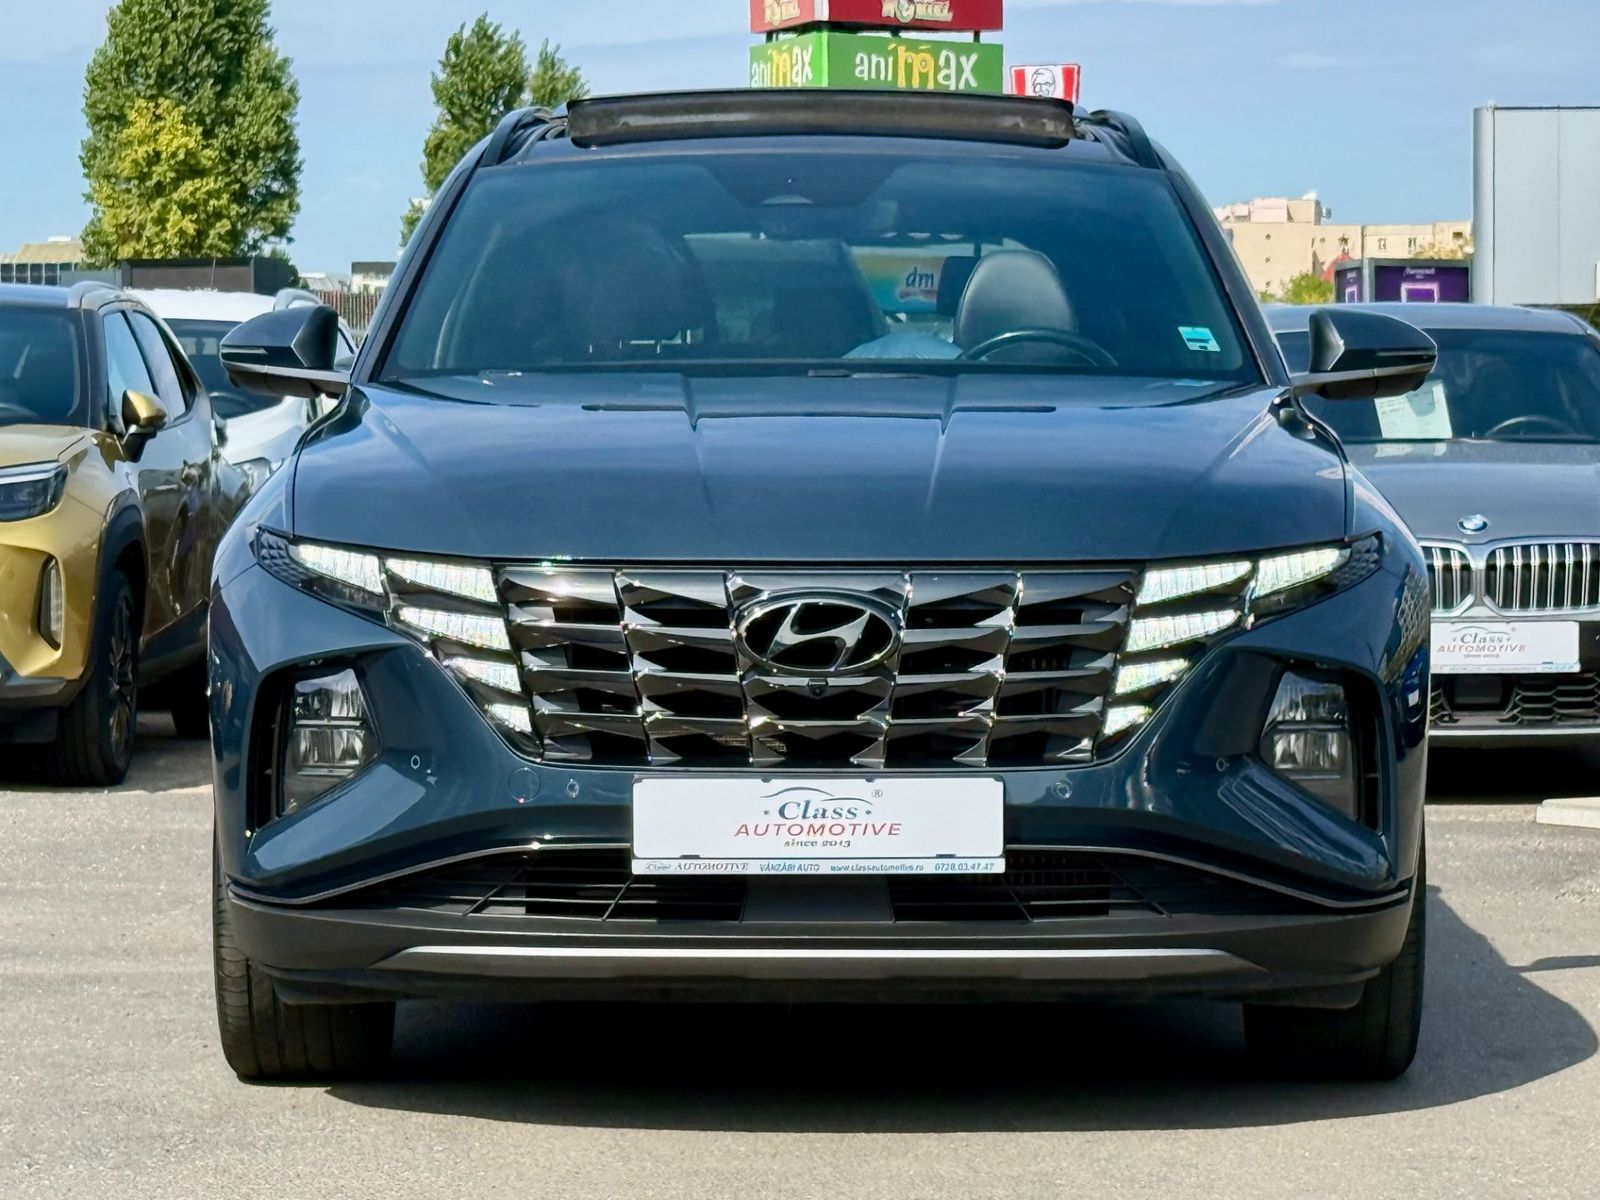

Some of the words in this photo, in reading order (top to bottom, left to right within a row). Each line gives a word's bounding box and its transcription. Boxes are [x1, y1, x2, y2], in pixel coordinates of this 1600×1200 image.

[855, 43, 978, 91] animax
[905, 265, 935, 289] dm
[777, 799, 859, 820] Class
[734, 822, 902, 837] AUTOMOTIVE
[784, 838, 818, 848] since
[821, 839, 851, 848] 2013
[796, 863, 820, 872] AUTO
